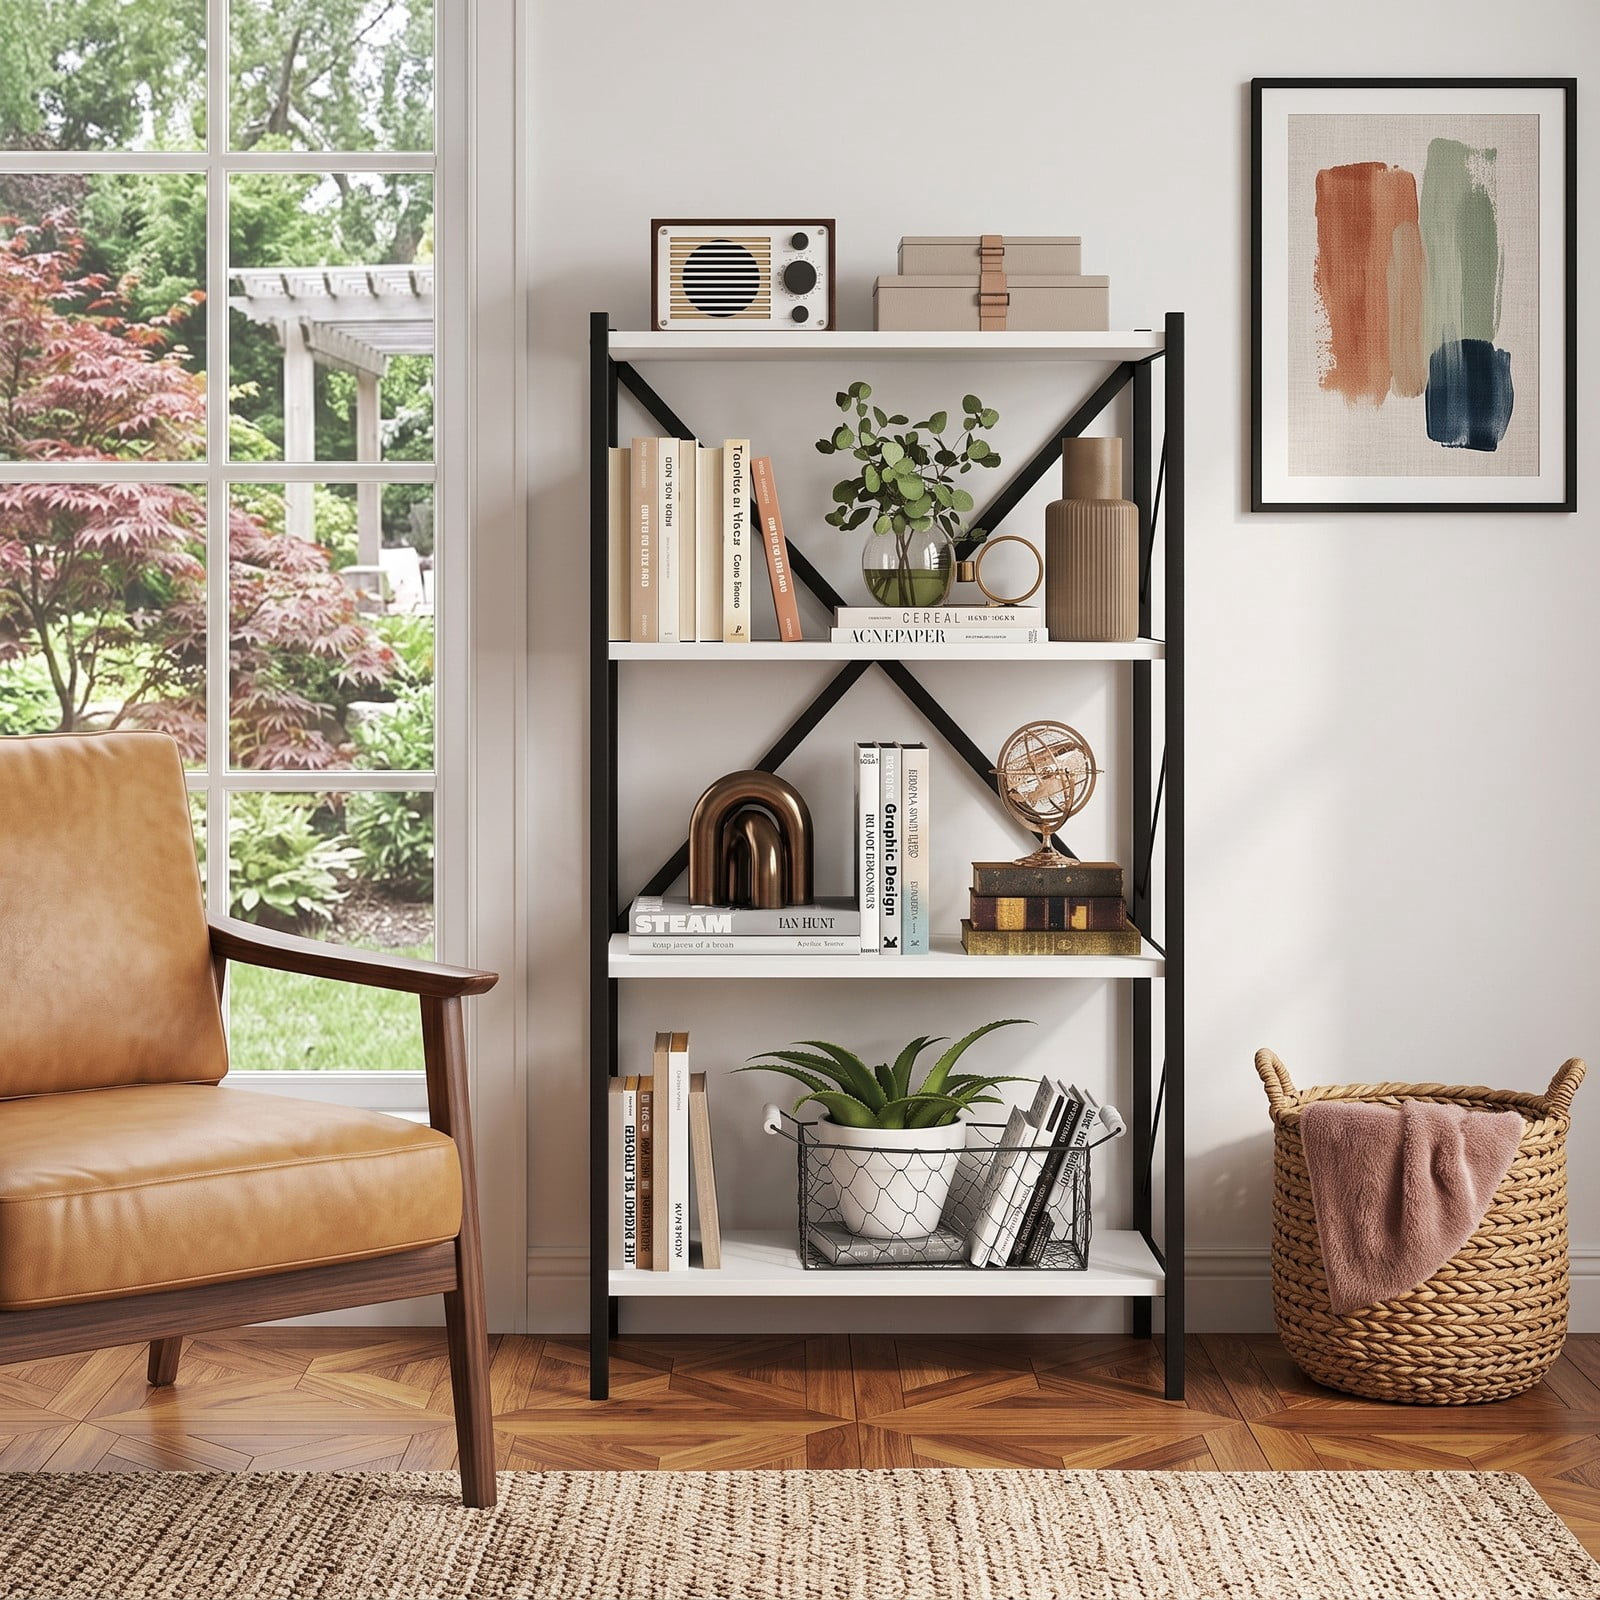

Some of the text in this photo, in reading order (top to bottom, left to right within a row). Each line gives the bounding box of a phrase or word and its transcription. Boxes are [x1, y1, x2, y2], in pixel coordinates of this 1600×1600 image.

[902, 612, 960, 624] CEREAL
[849, 629, 945, 643] ACNEPAPER
[883, 803, 898, 861] Graphic
[883, 866, 898, 916] Design
[635, 914, 732, 933] STEAM
[778, 917, 835, 929] IAN HUNT
